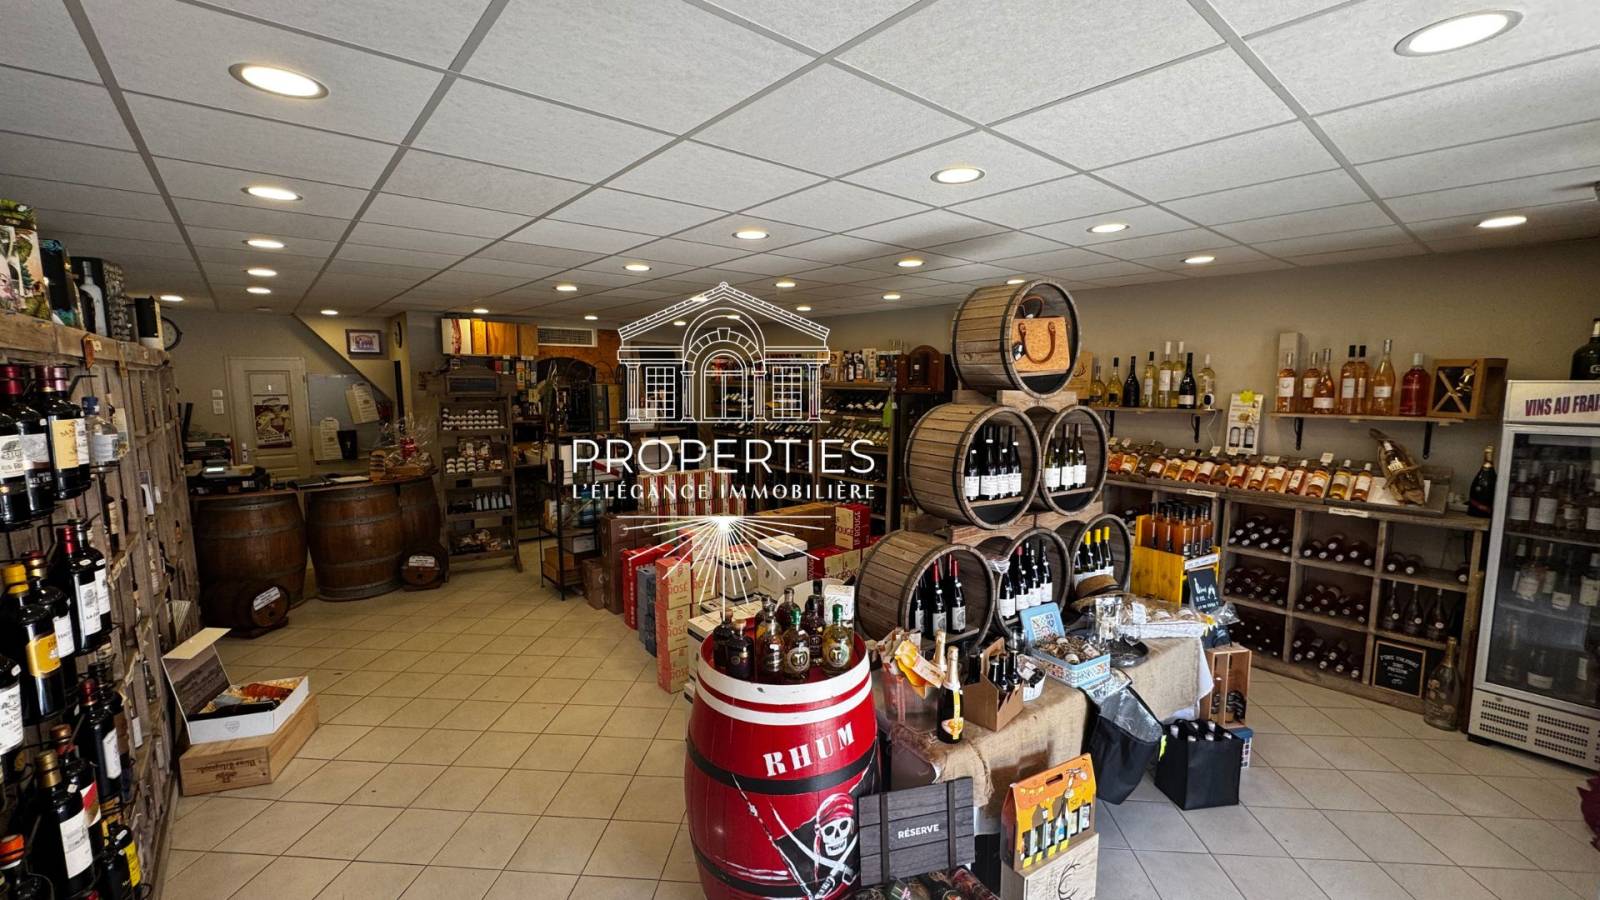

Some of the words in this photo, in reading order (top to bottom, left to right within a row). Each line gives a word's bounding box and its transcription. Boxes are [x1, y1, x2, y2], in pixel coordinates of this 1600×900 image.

[1525, 398, 1553, 416] VINS
[1553, 396, 1571, 415] AU
[1572, 394, 1600, 413] FRAI
[762, 721, 856, 778] RHUM
[898, 823, 940, 839] RÉSERVE
